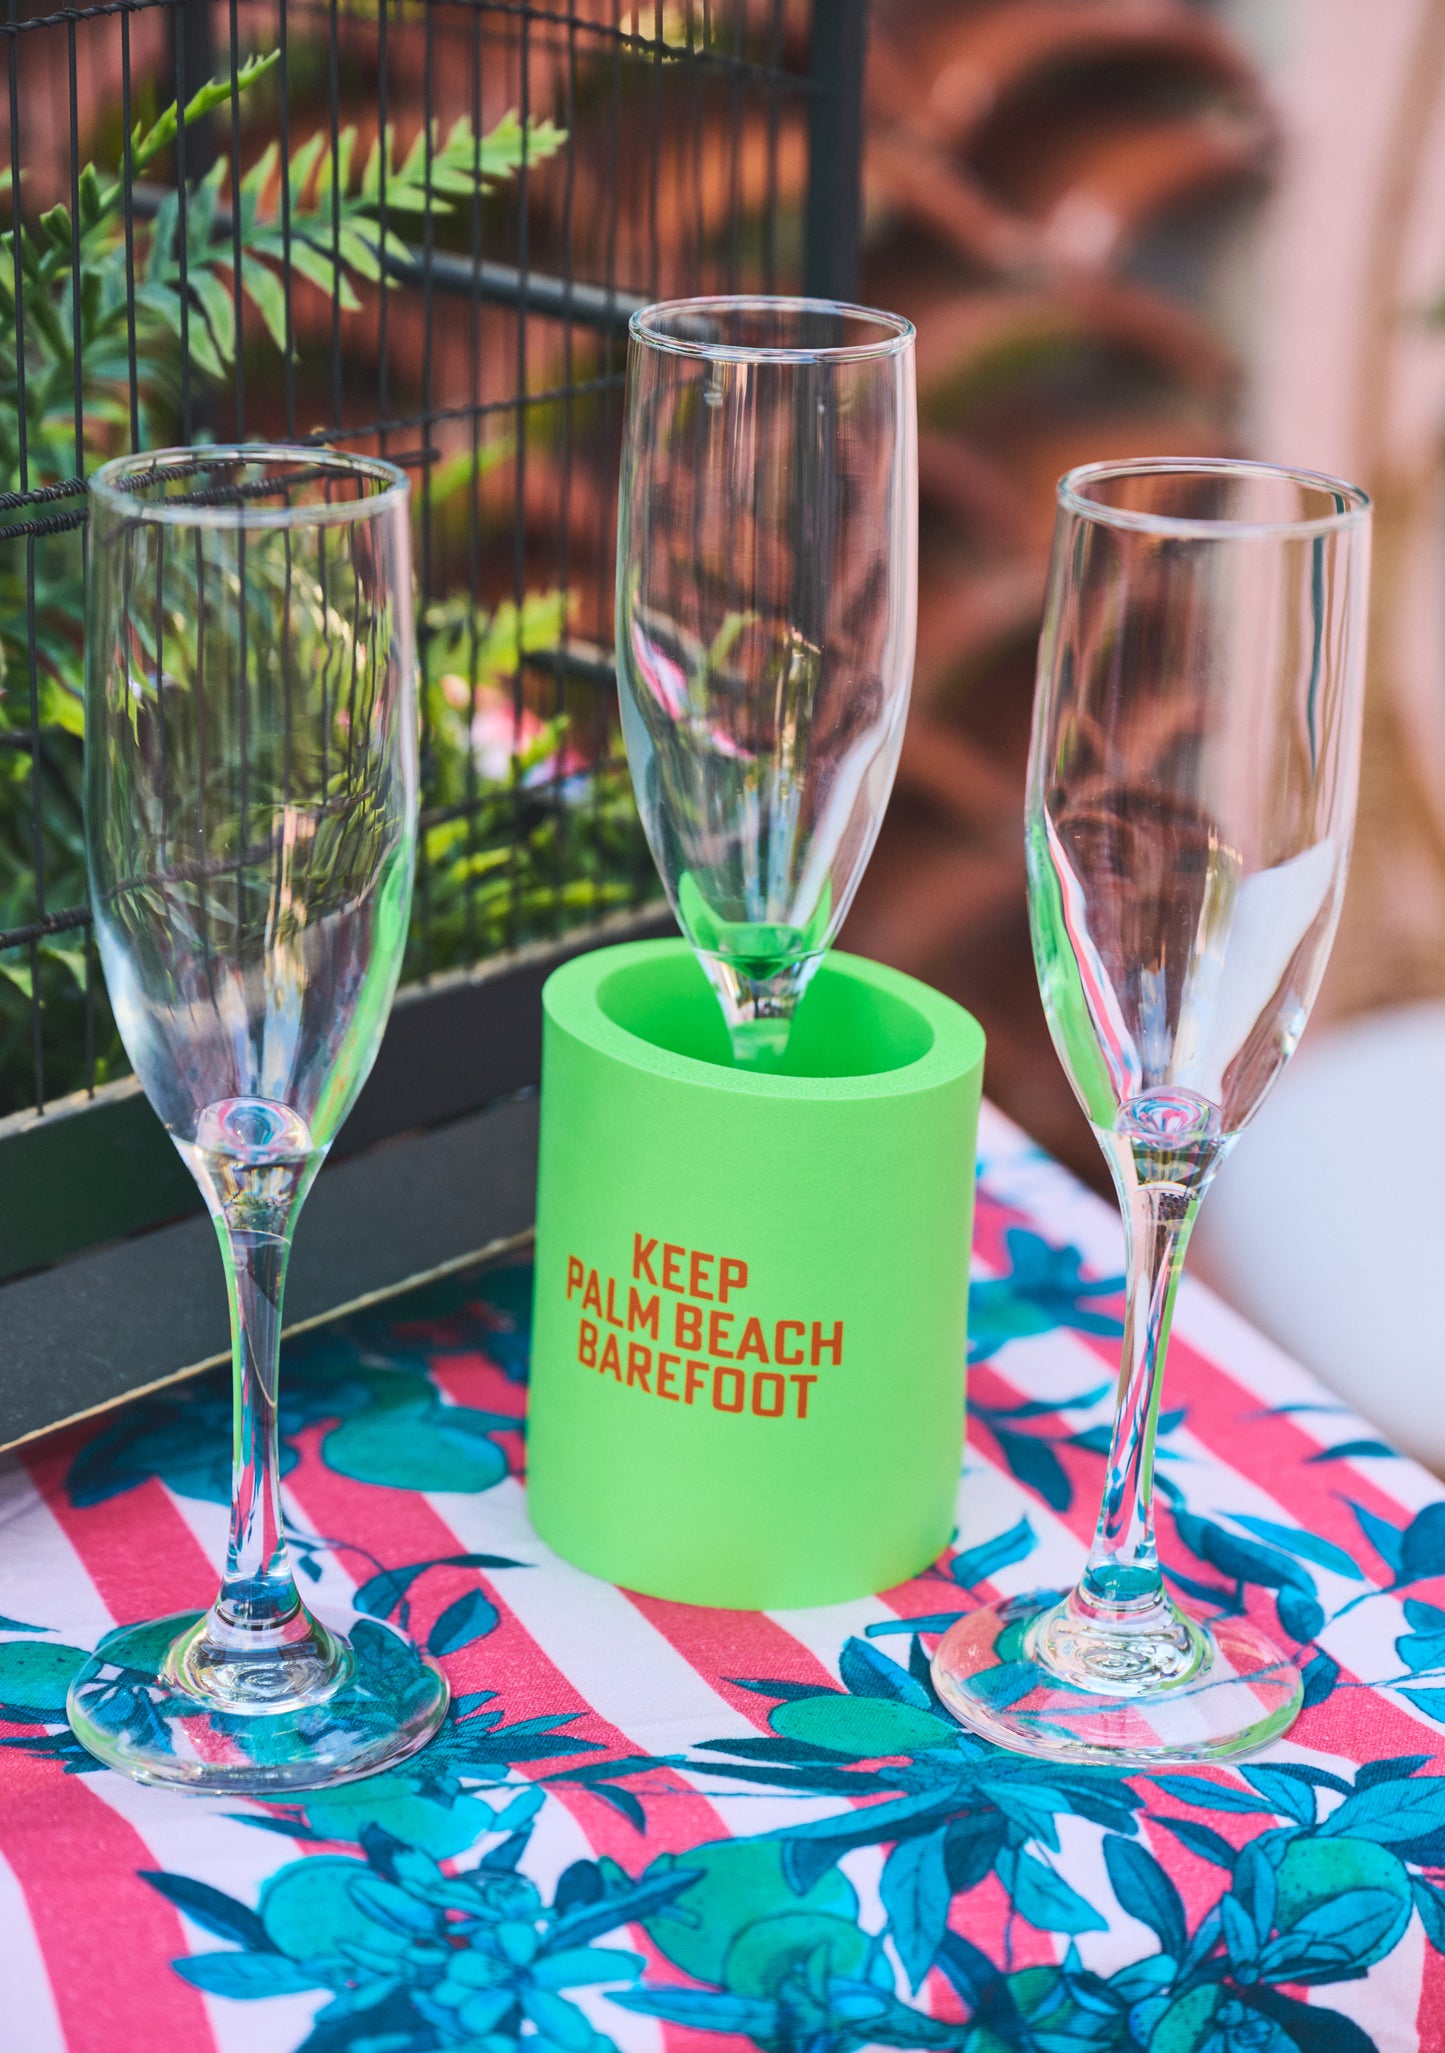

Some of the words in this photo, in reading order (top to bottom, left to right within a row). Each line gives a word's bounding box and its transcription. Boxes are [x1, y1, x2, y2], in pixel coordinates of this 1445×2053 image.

[566, 1253, 661, 1342] PALM
[674, 1302, 844, 1367] BEACH
[632, 1232, 748, 1304] KEEP
[577, 1317, 818, 1420] BAREFOOT
